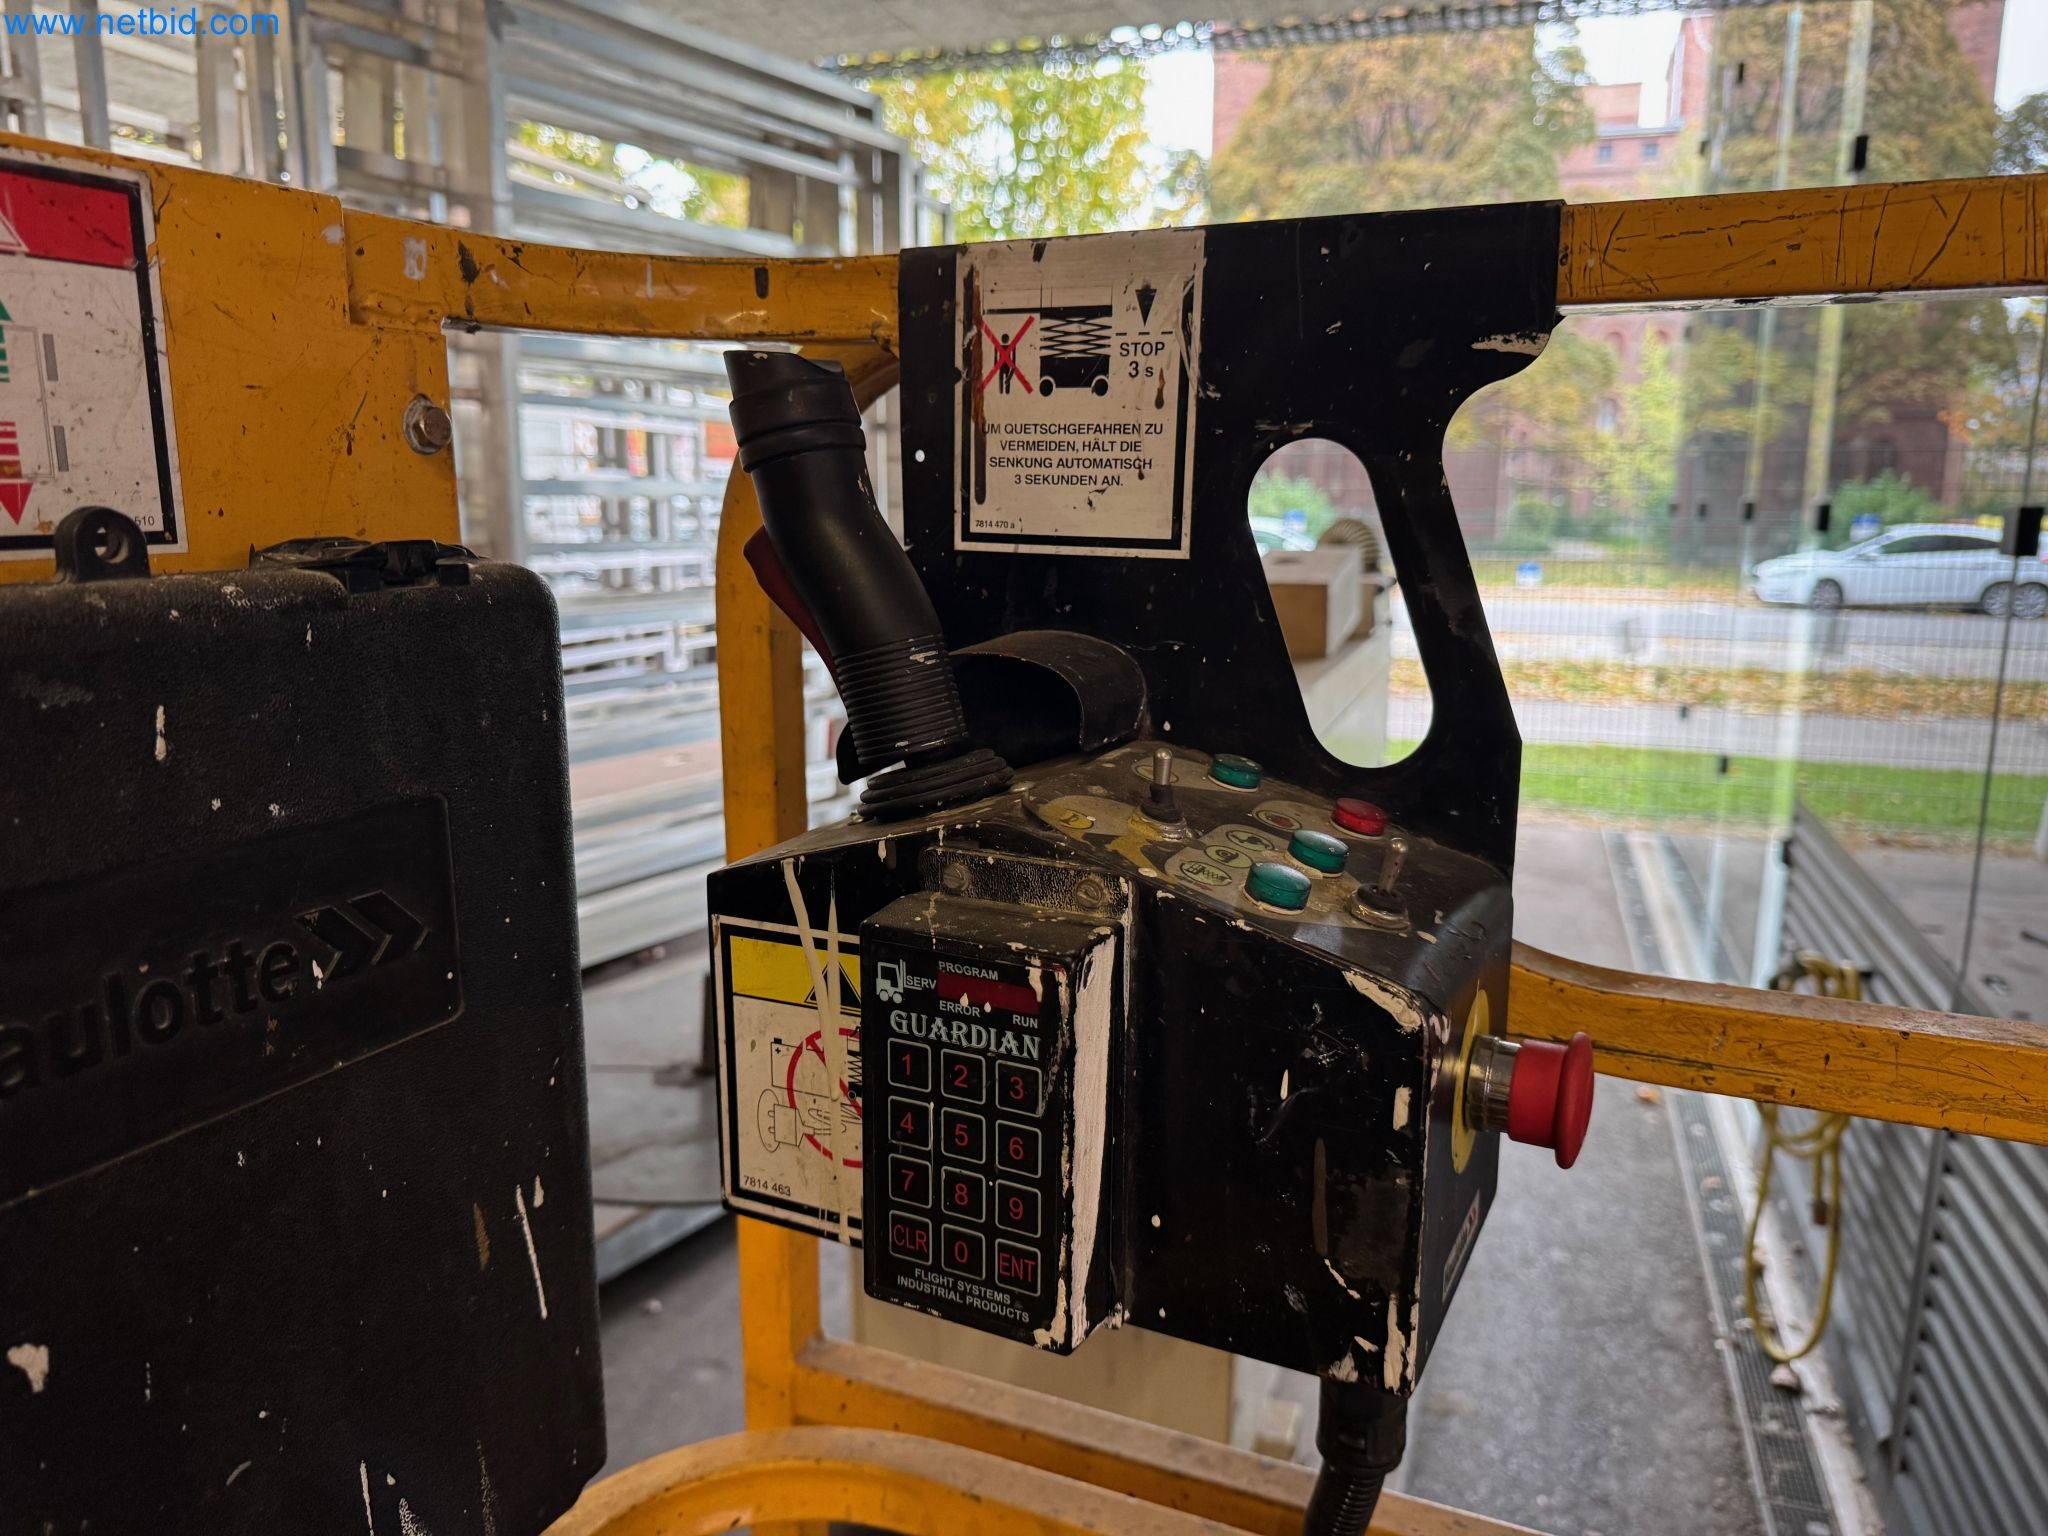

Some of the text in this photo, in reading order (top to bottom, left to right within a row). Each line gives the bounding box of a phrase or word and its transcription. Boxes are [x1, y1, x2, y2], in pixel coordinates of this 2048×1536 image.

[1119, 341, 1165, 357] STOP
[1128, 360, 1154, 378] 3 s
[982, 423, 1163, 435] UM QUETSCHGEFAHREN ZU
[1000, 437, 1142, 454] VERMEIDEN, HÄLT DIE
[989, 456, 1152, 470] SENKUNG AUTOMATISCH
[1014, 474, 1124, 487] 3 SEKUNDEN AN.
[975, 519, 993, 528] 7814
[994, 520, 1009, 529] 470
[938, 960, 999, 981] PROGRAM
[906, 975, 937, 990] SERV
[939, 999, 981, 1018] ERROR
[1012, 1014, 1039, 1029] RUN
[889, 1009, 1042, 1061] GUARDIAN
[902, 1053, 1024, 1100] 1 2 3
[900, 1111, 1024, 1160] 4 5 6
[743, 1174, 791, 1197] 7814 463
[901, 1169, 1024, 1220] 7 8 9
[893, 1224, 1036, 1282] CLR 0 ENT
[914, 1268, 1011, 1305] FLIGHT SYSTEMS
[897, 1275, 1030, 1323] INDUSTRIAL PRODUCTS
